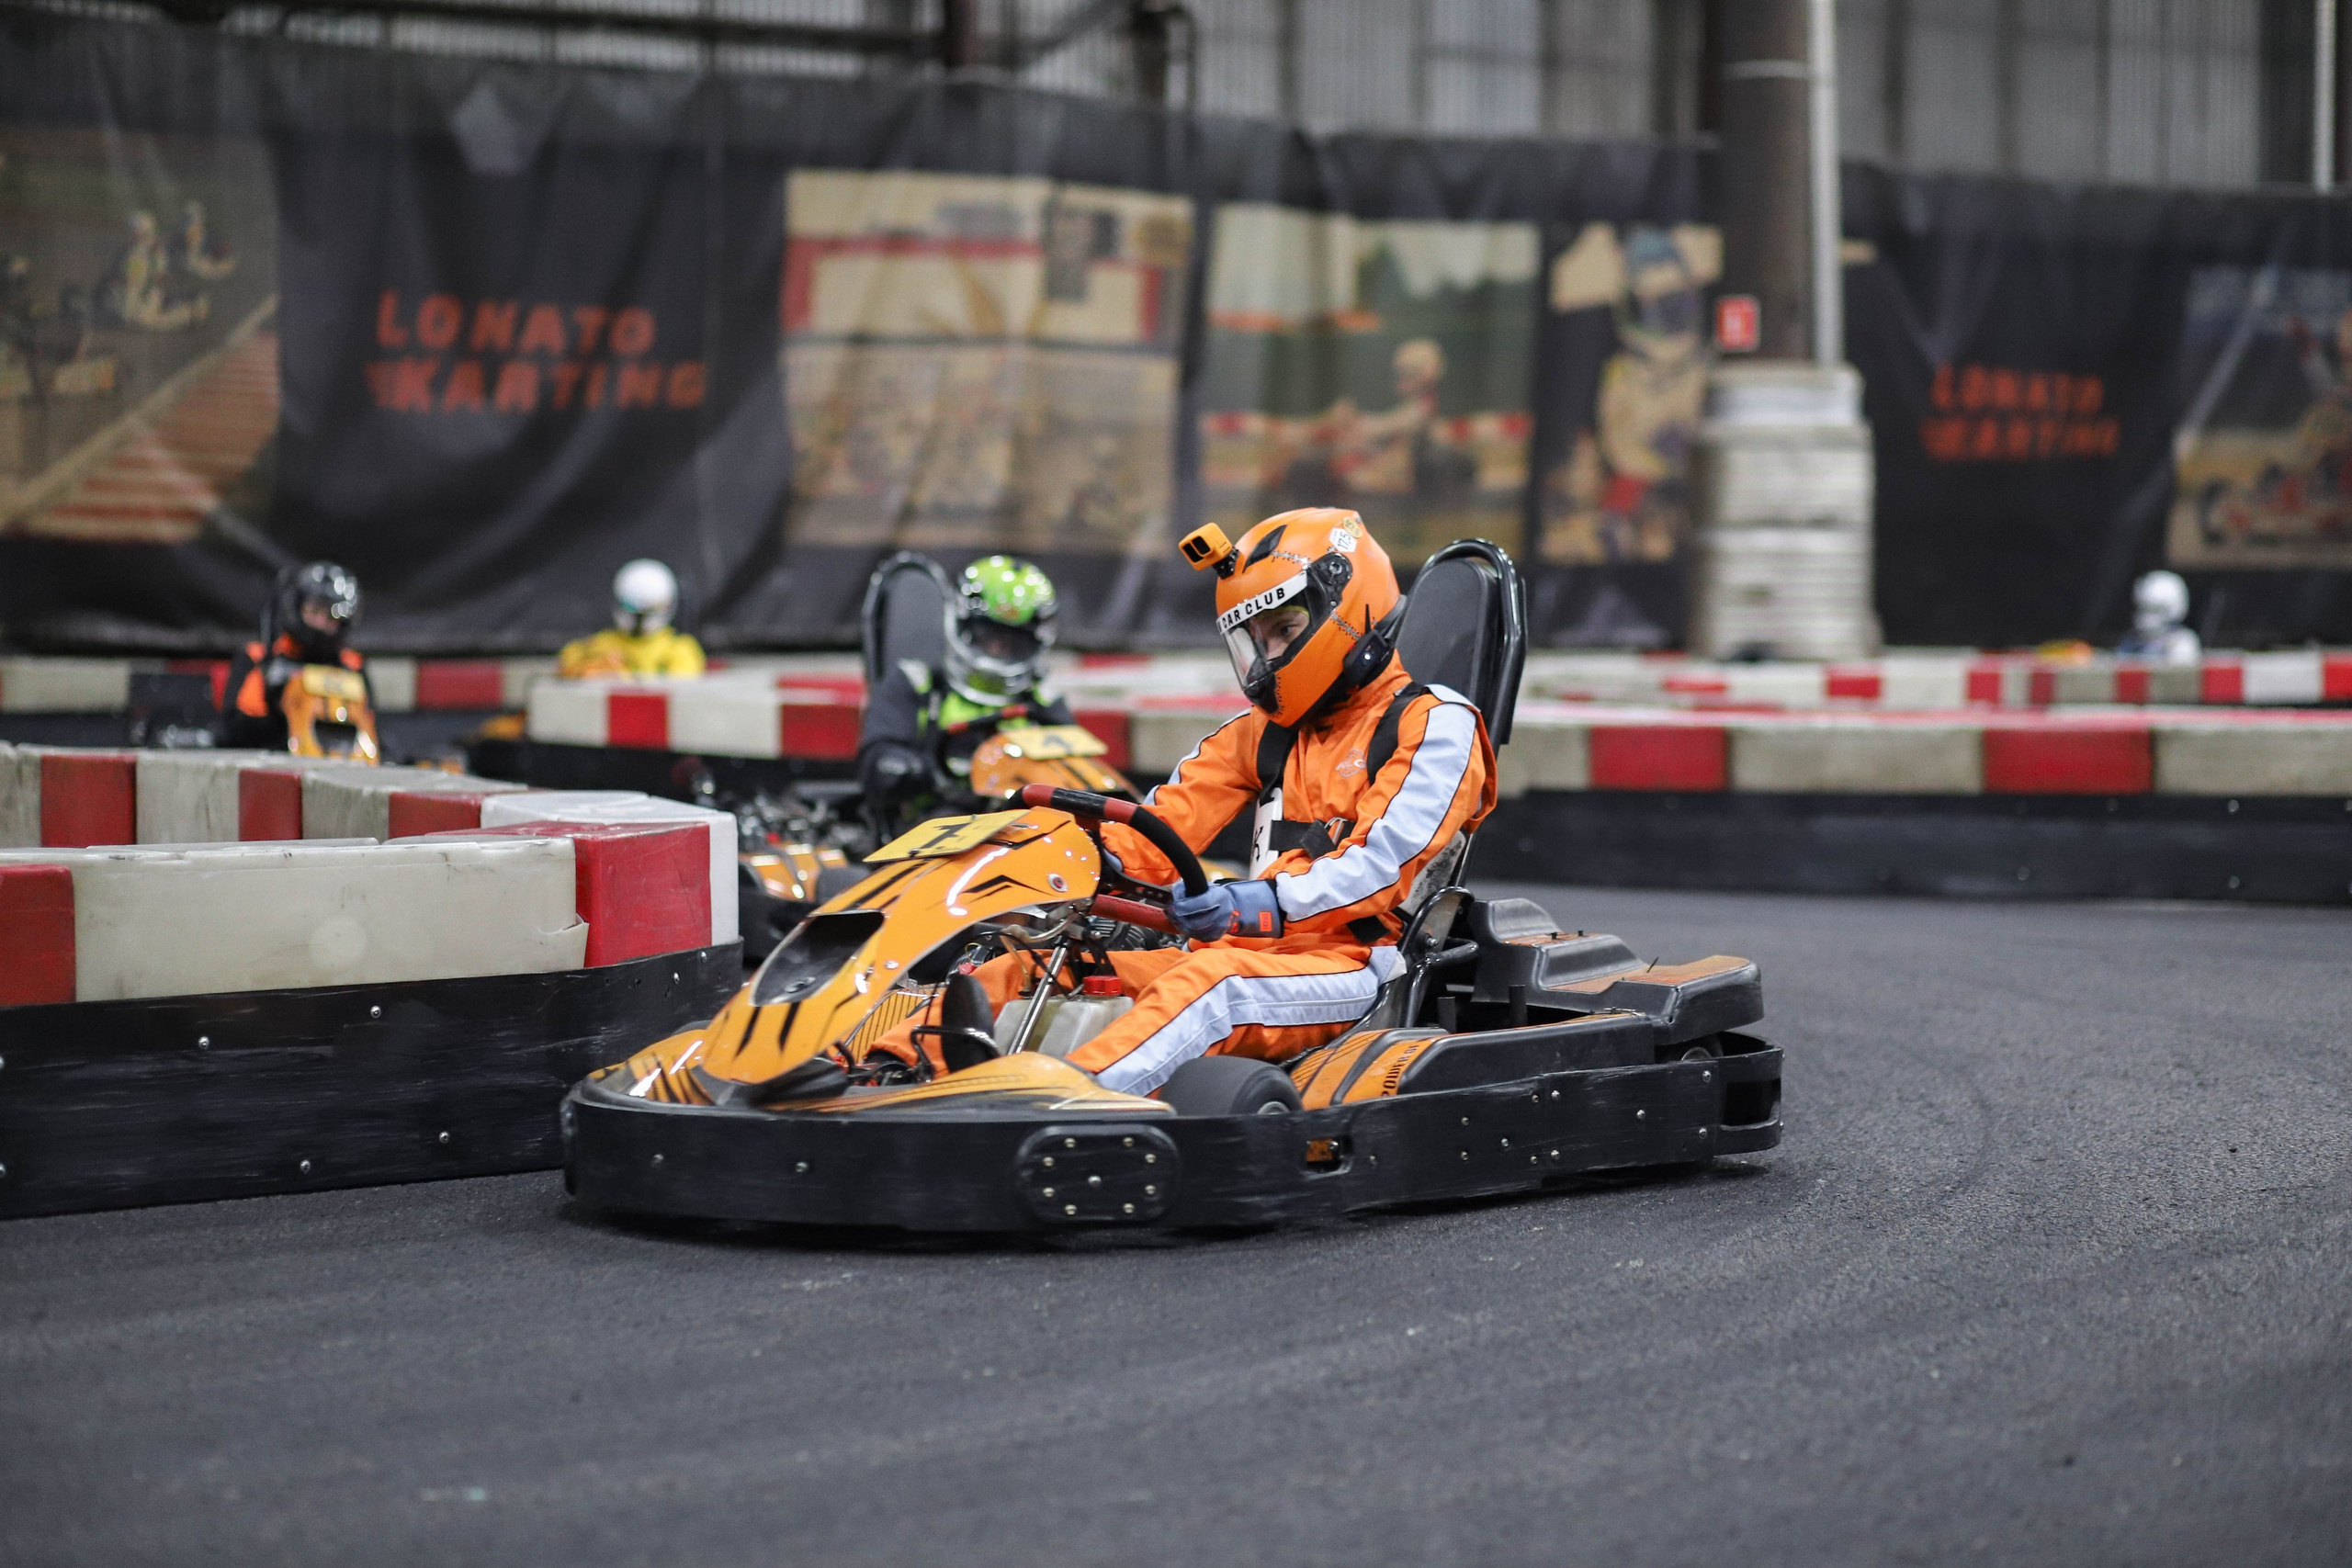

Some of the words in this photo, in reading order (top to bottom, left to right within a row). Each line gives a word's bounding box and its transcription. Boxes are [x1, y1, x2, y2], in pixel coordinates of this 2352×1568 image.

[376, 288, 657, 355] LONATO
[366, 356, 707, 414] KARTING
[1222, 608, 1241, 629] CAR
[1245, 587, 1285, 615] CLUB
